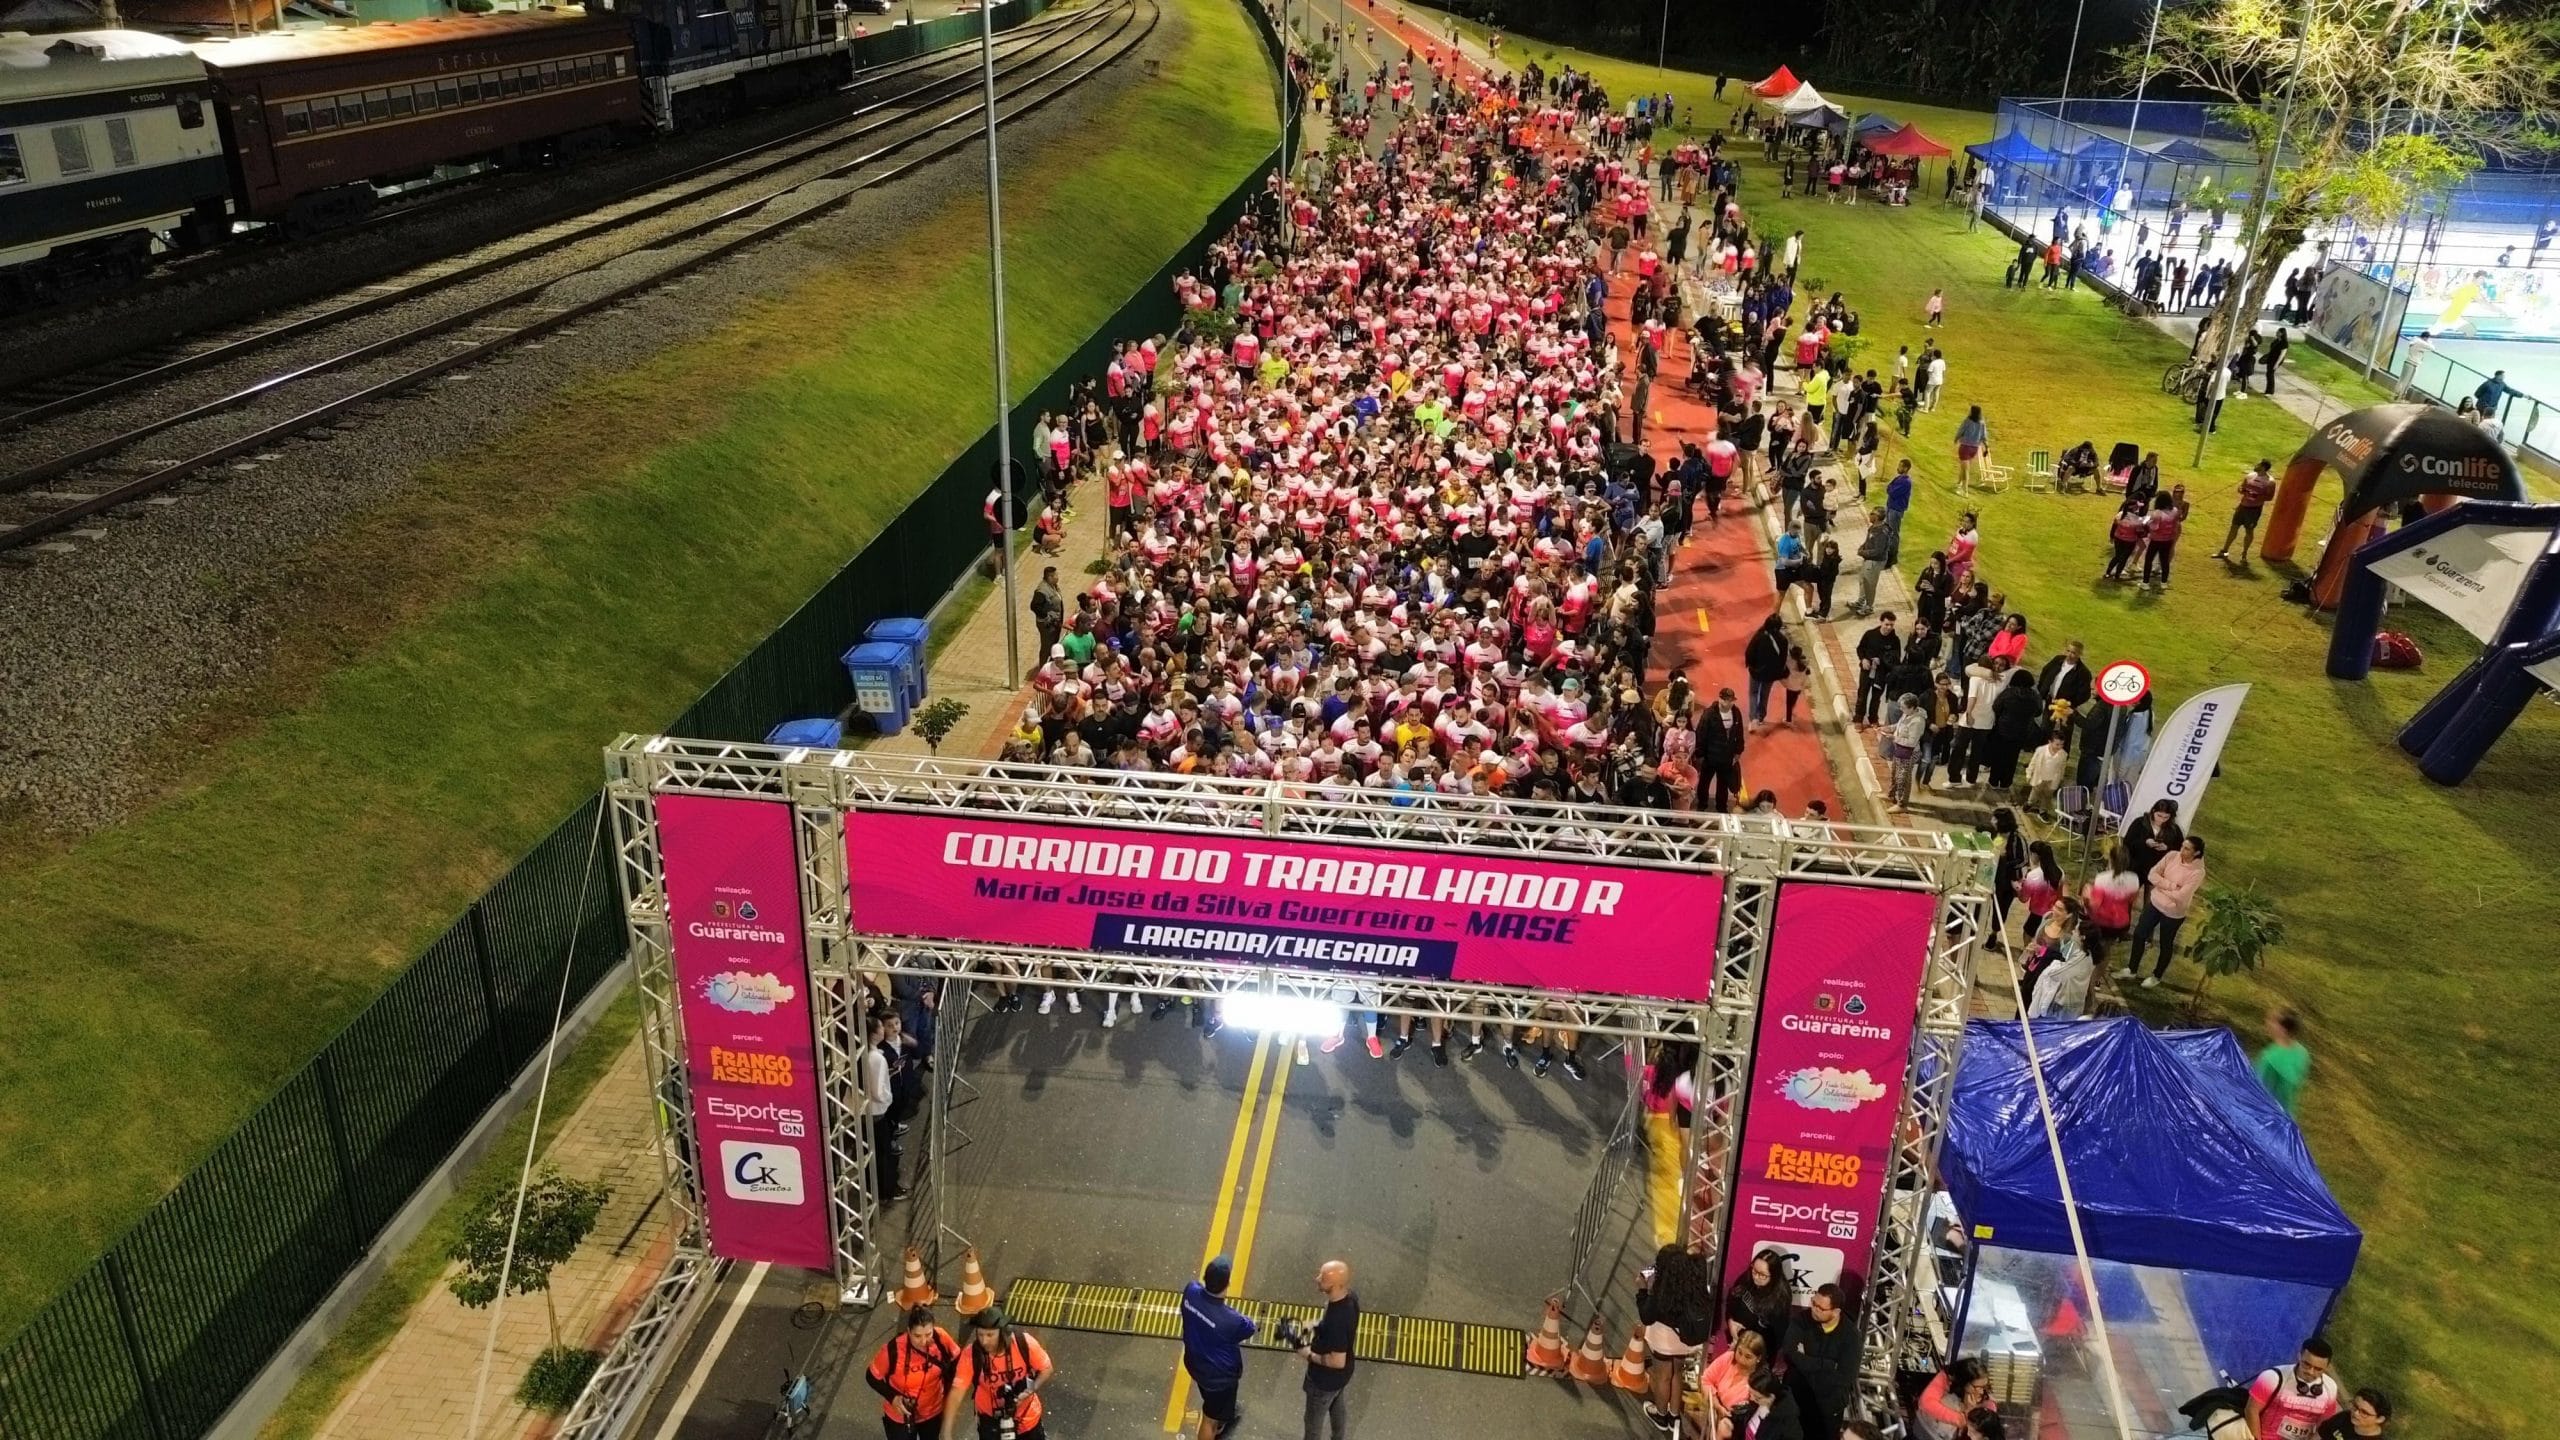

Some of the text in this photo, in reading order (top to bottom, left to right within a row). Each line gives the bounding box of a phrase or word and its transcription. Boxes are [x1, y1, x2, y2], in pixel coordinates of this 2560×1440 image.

[85, 195, 123, 209] PRIMEIRA
[2335, 429, 2374, 460] Conlife
[2421, 453, 2500, 479] Conlife
[2448, 478, 2498, 491] telecom
[2436, 561, 2486, 592] Guararema
[2166, 702, 2219, 796] Guararema
[943, 831, 1155, 879] CORRIDA
[1160, 847, 1232, 884] DO
[973, 876, 1061, 904] Maria
[1066, 883, 1145, 910] José
[1151, 890, 1189, 914] da
[1195, 894, 1273, 919] Silva
[1277, 900, 1435, 933] Guerreiro
[1464, 910, 1581, 945] MASÉ
[688, 922, 786, 944] Guararema
[1123, 923, 1420, 967] LARGADA/CHEGADA
[1823, 977, 1867, 989] realização:
[1781, 1014, 1891, 1041] Guararema
[1804, 1014, 1855, 1025] PREFEITURA
[710, 1045, 792, 1073] FRANGO
[1818, 1051, 1844, 1061] apoio:
[711, 1065, 794, 1088] ASSADO
[707, 1096, 804, 1123] Esportes
[781, 1124, 803, 1136] ON
[1800, 1131, 1836, 1142] parceria:
[735, 1152, 781, 1185] CK
[1767, 1143, 1861, 1173] FRANGO
[749, 1184, 793, 1193] Eventos
[1764, 1163, 1859, 1188] ASSADO
[1750, 1195, 1860, 1225] Esportes
[1830, 1225, 1855, 1238] ON
